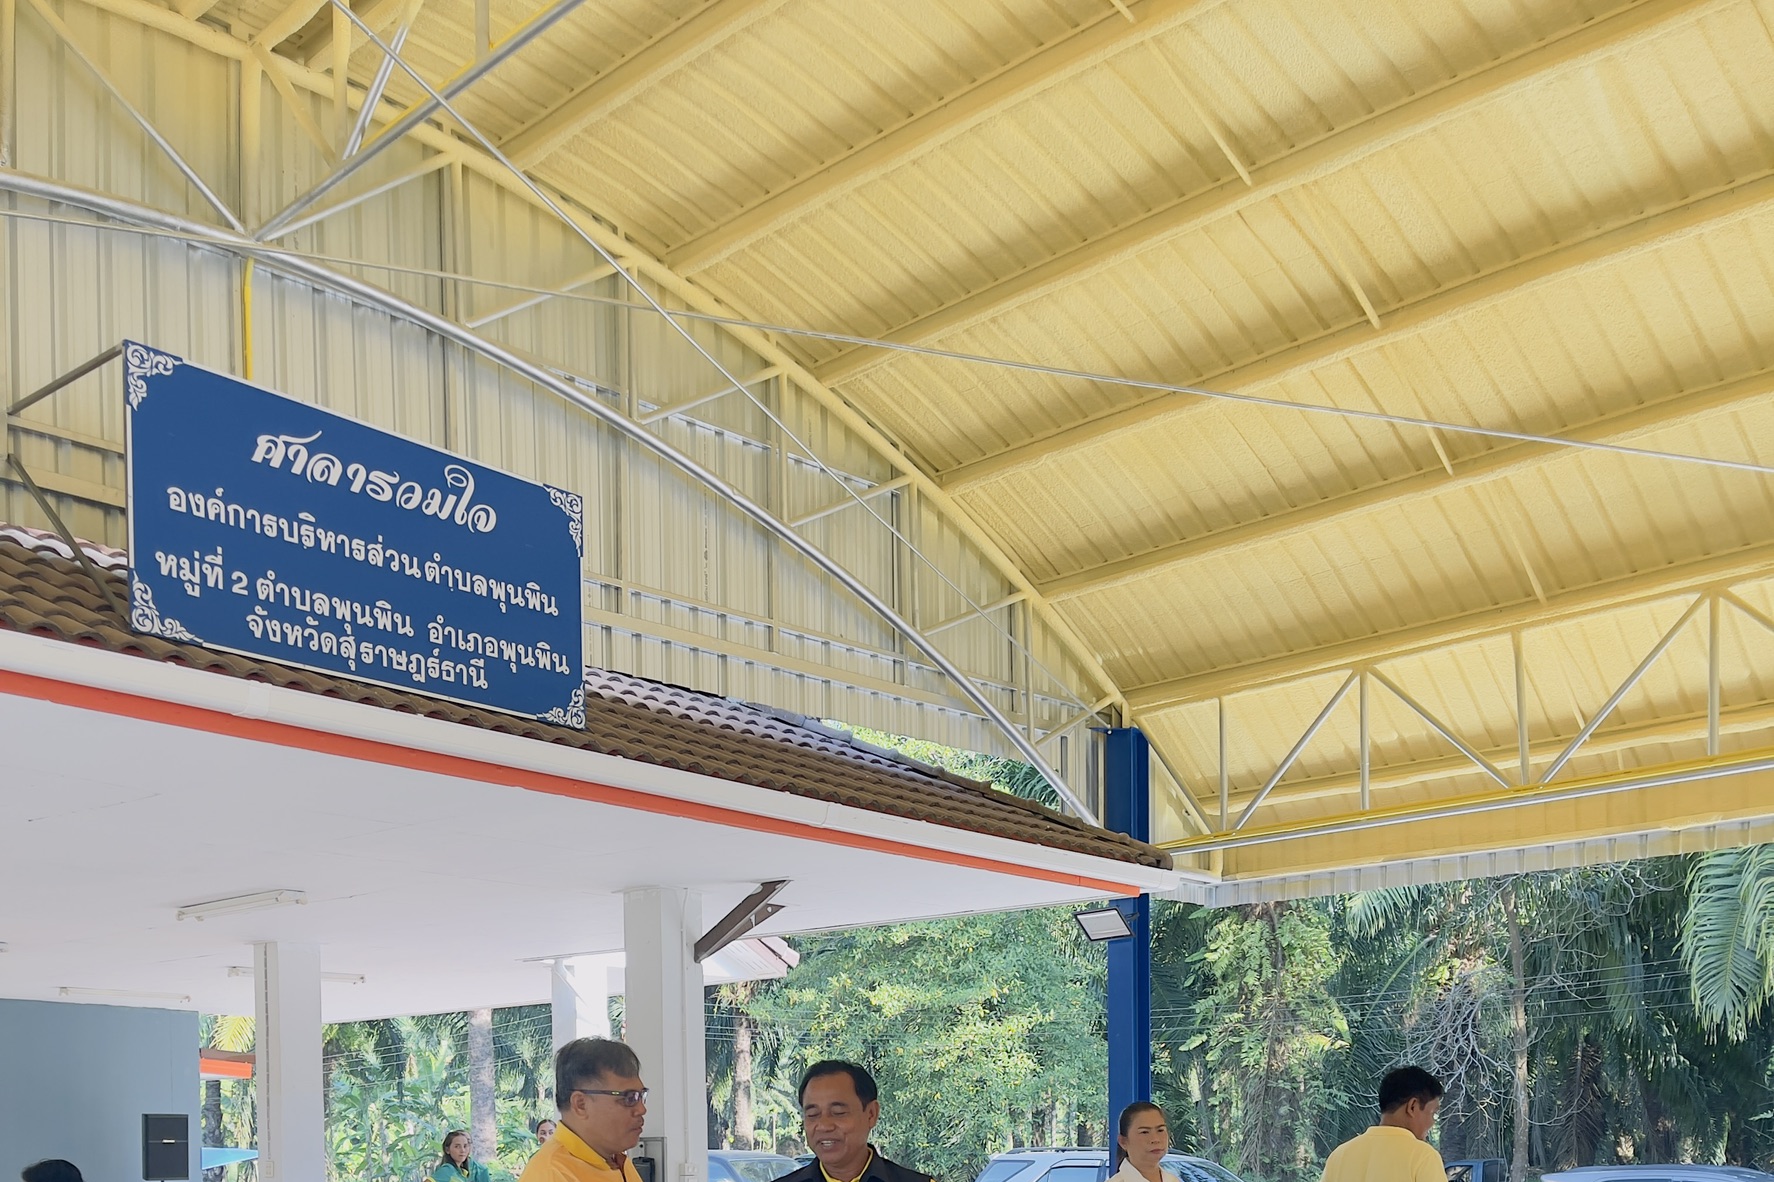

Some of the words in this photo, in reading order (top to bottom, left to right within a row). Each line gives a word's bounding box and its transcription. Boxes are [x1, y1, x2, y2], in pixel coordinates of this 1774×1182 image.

[251, 430, 497, 533] ศาลารวมใจ
[155, 546, 224, 598] หมู่ที่
[232, 571, 249, 596] 2
[256, 570, 415, 637] ตำบลพุนพิน
[427, 615, 570, 675] อำเภอพุนพิน
